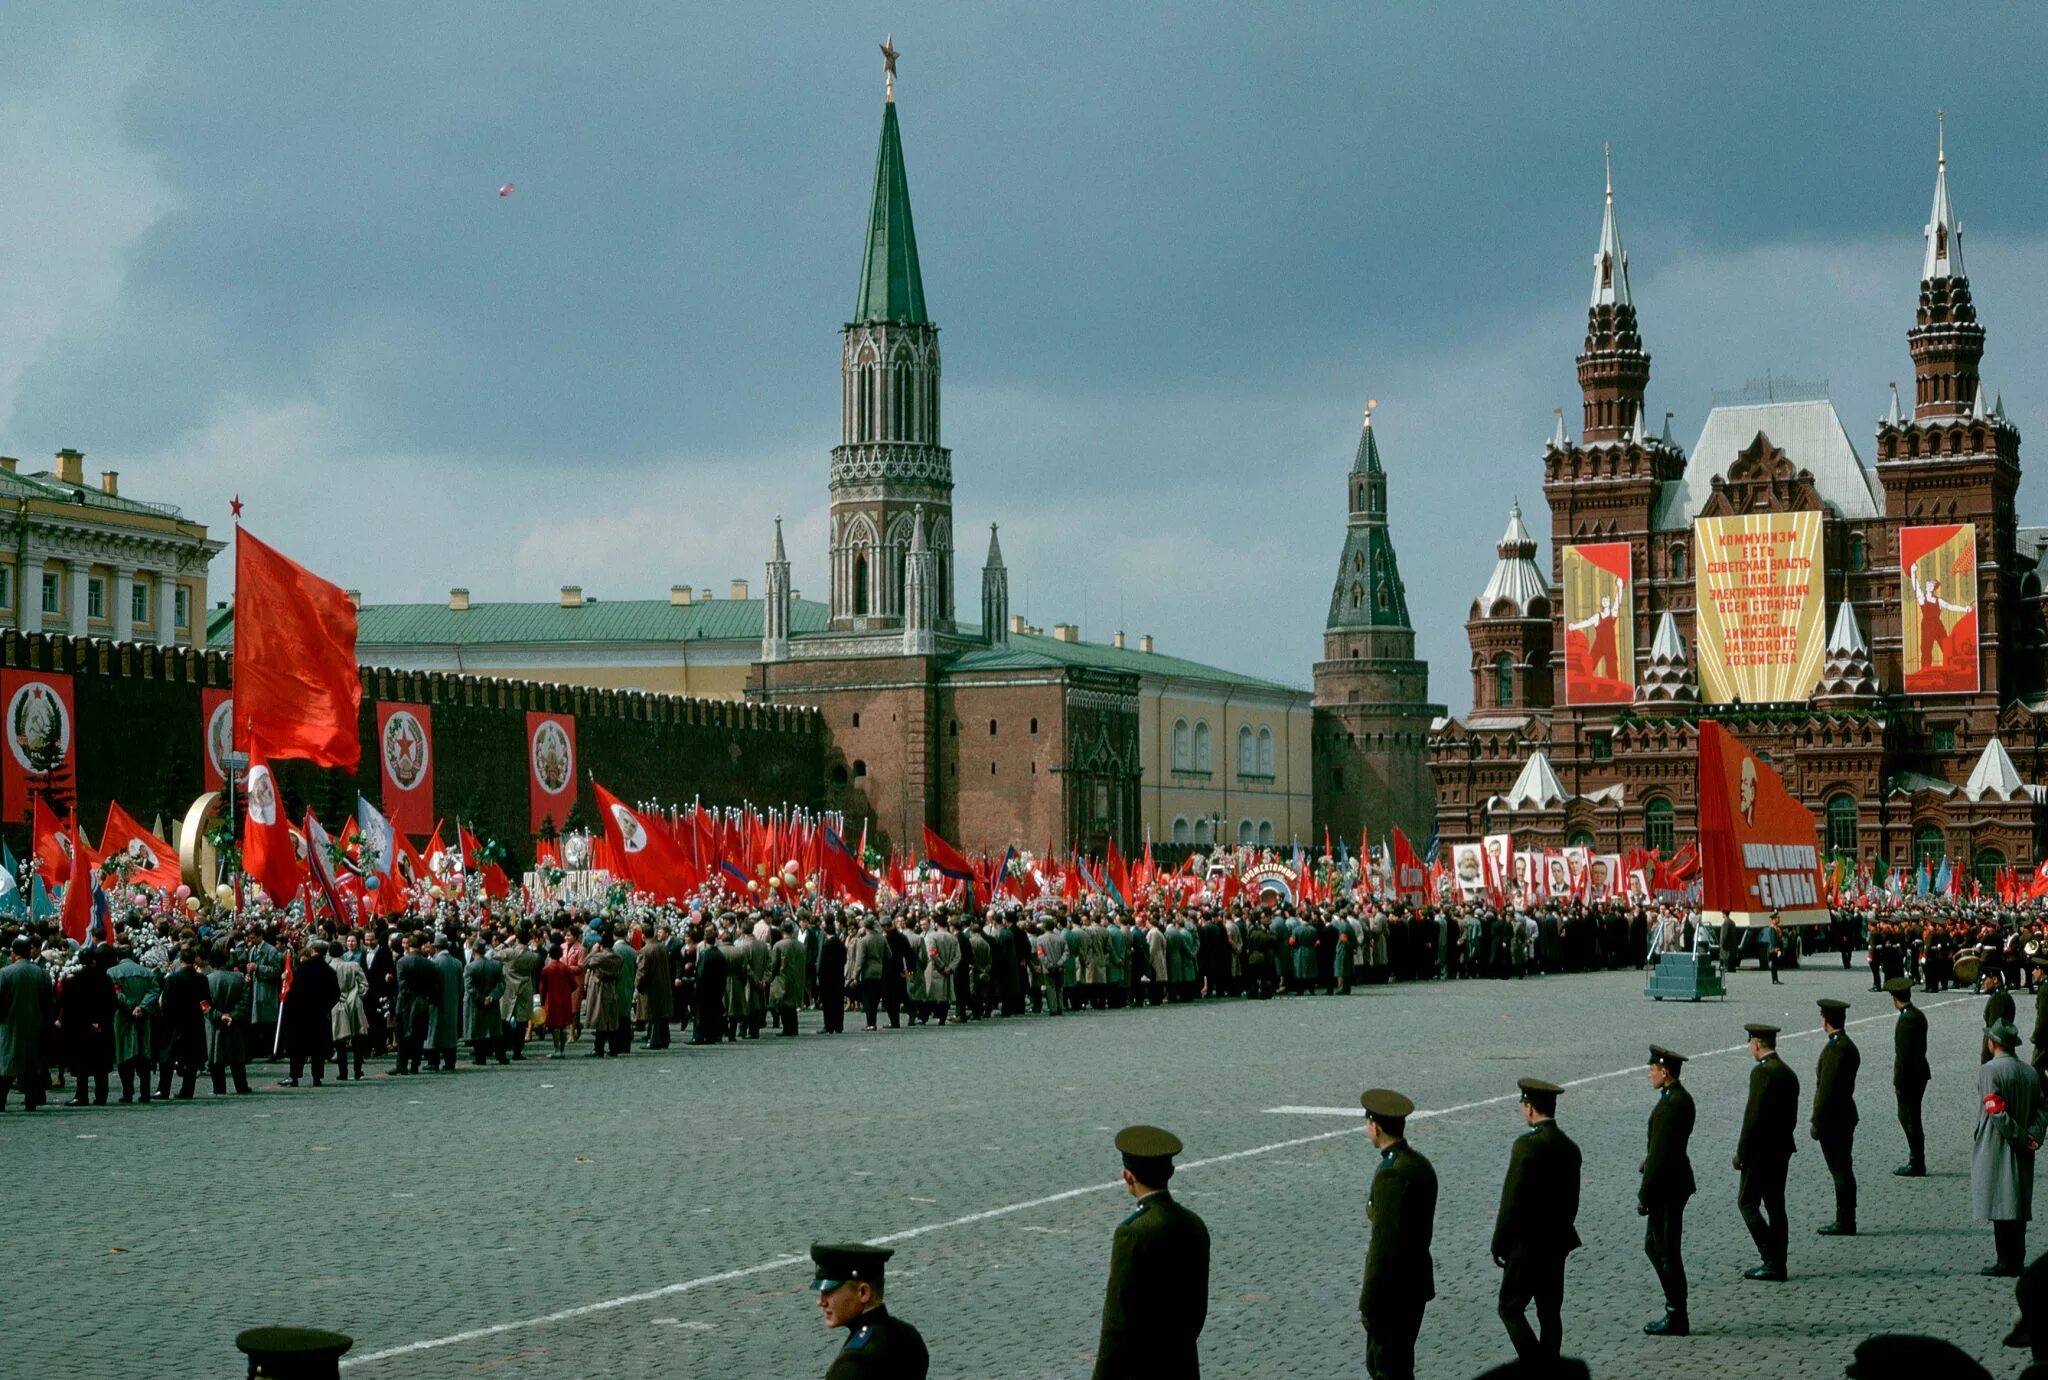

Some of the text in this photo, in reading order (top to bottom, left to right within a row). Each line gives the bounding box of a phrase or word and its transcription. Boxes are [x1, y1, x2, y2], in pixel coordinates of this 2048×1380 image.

[1719, 531, 1797, 546] КОММУНИЗМ
[1743, 547, 1775, 558] ЕСТЬ
[1707, 557, 1811, 573] СОВЕТСКАЯ ВЛАСТЬ
[1742, 573, 1777, 585] ПЛЮС
[1709, 584, 1810, 601] ЭЛЕКТРИФИКАЦИЯ
[1742, 614, 1778, 626] ПЛЮС
[1725, 626, 1797, 639] ХИМИЗАЦИЯ
[1724, 639, 1797, 652] НАРОДНОГО
[1742, 843, 1778, 871] НАРОД
[1774, 845, 1786, 870] И
